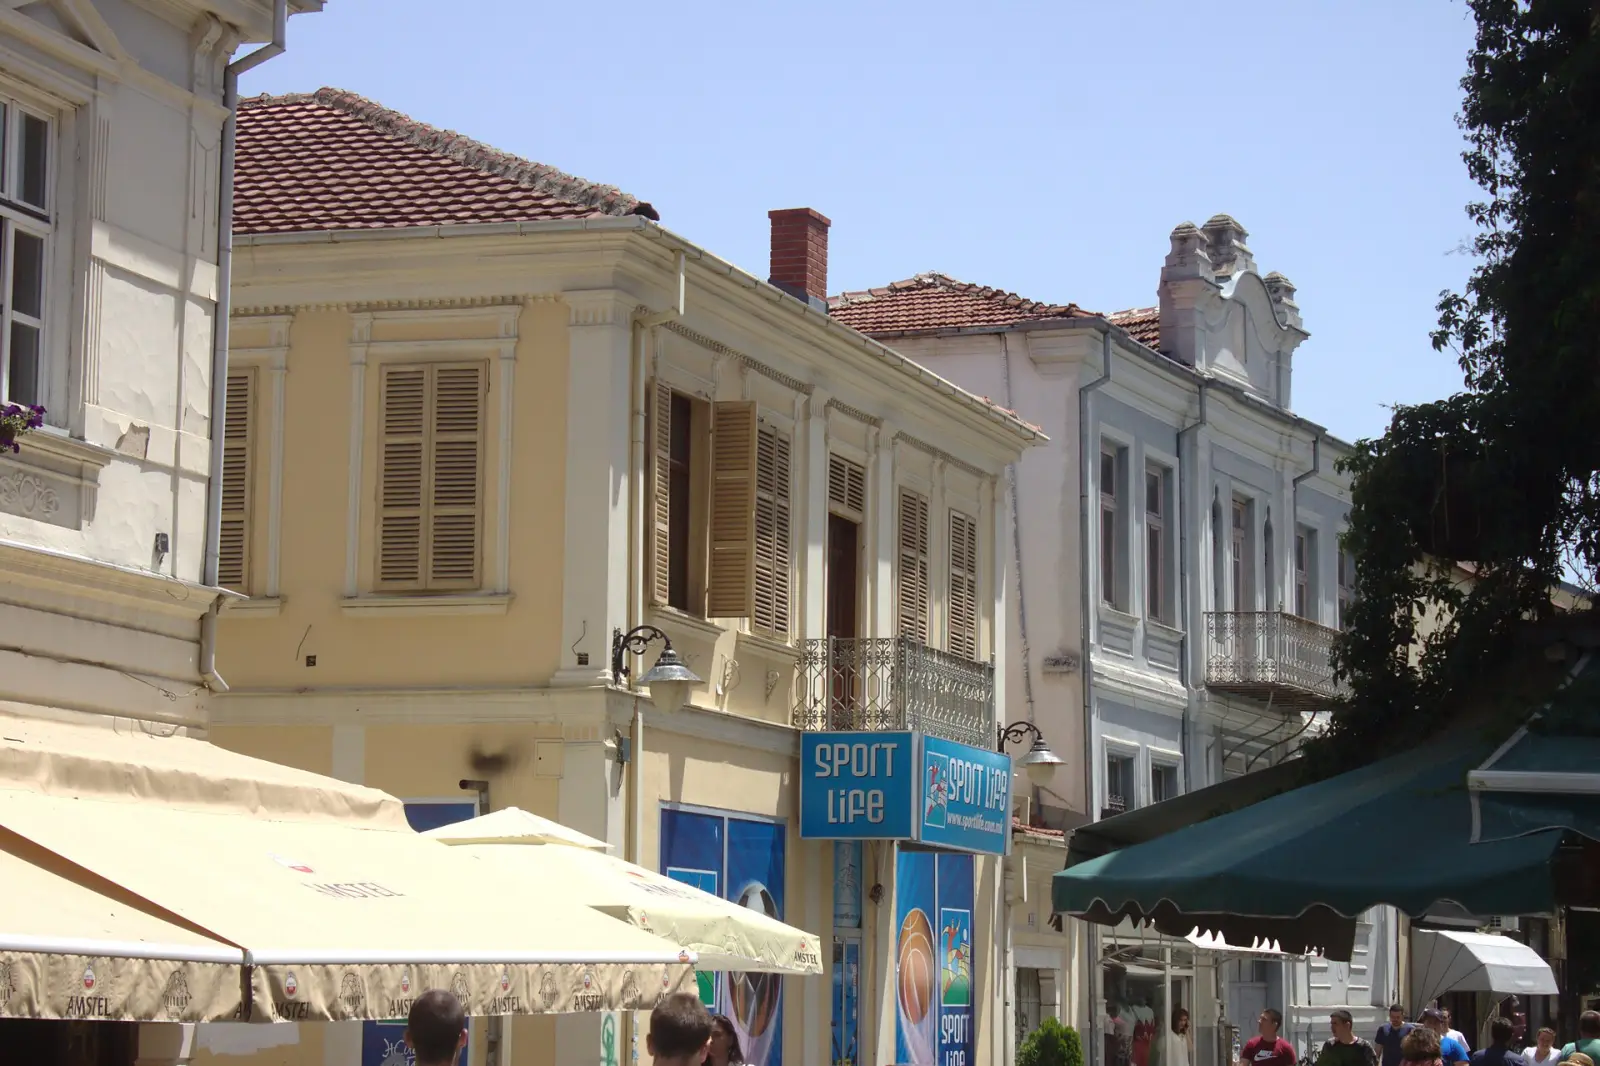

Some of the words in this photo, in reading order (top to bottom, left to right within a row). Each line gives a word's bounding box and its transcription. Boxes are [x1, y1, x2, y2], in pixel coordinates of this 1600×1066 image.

[947, 812, 1004, 834] www.sportlife.com.mk
[794, 951, 818, 965] AMSTEL
[66, 995, 111, 1017] AMSTEL
[491, 996, 521, 1013] AMSTEL
